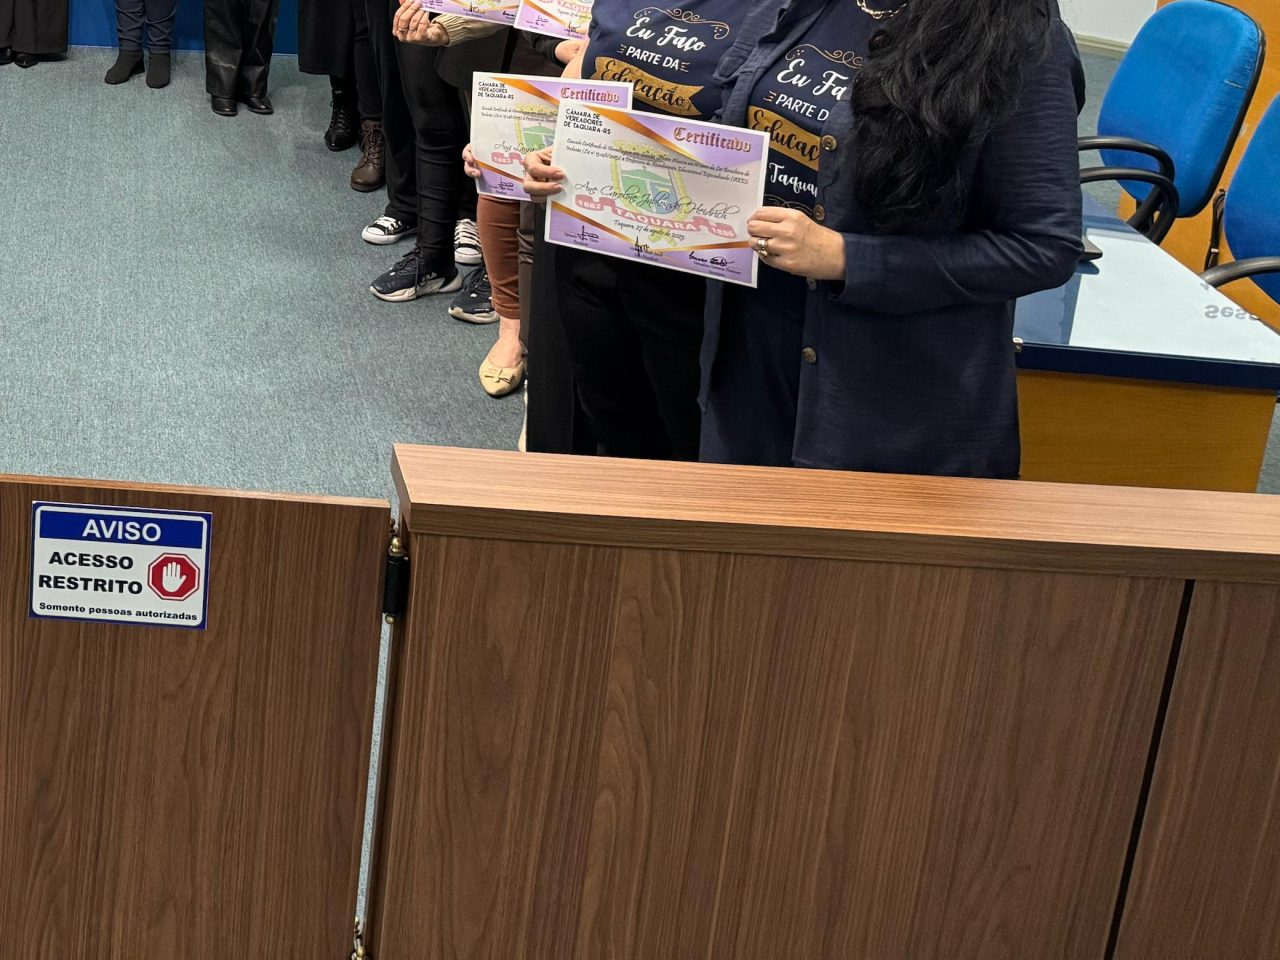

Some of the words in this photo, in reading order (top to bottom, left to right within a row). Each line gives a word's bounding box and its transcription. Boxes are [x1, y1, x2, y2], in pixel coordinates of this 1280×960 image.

[625, 16, 656, 41] Eu
[656, 25, 707, 55] Faço
[625, 45, 661, 67] PARTE
[662, 55, 680, 72] DA
[599, 59, 686, 108] Educação
[775, 57, 813, 88] Eu
[814, 69, 849, 101] Fa
[560, 86, 620, 103] Certificado
[565, 108, 591, 118] CÂMARA
[775, 93, 816, 118] PARTE
[817, 106, 830, 123] D
[565, 115, 603, 127] VEREADORES
[673, 126, 752, 153] Certificado
[751, 109, 820, 163] Educaç
[614, 207, 697, 231] TAQUARA
[82, 518, 162, 542] AVISO
[48, 551, 134, 570] ACESSO
[38, 574, 143, 595] RESTRITO
[39, 602, 86, 613] Somente
[88, 606, 132, 617] pessoas
[135, 609, 198, 621] autorizadas
